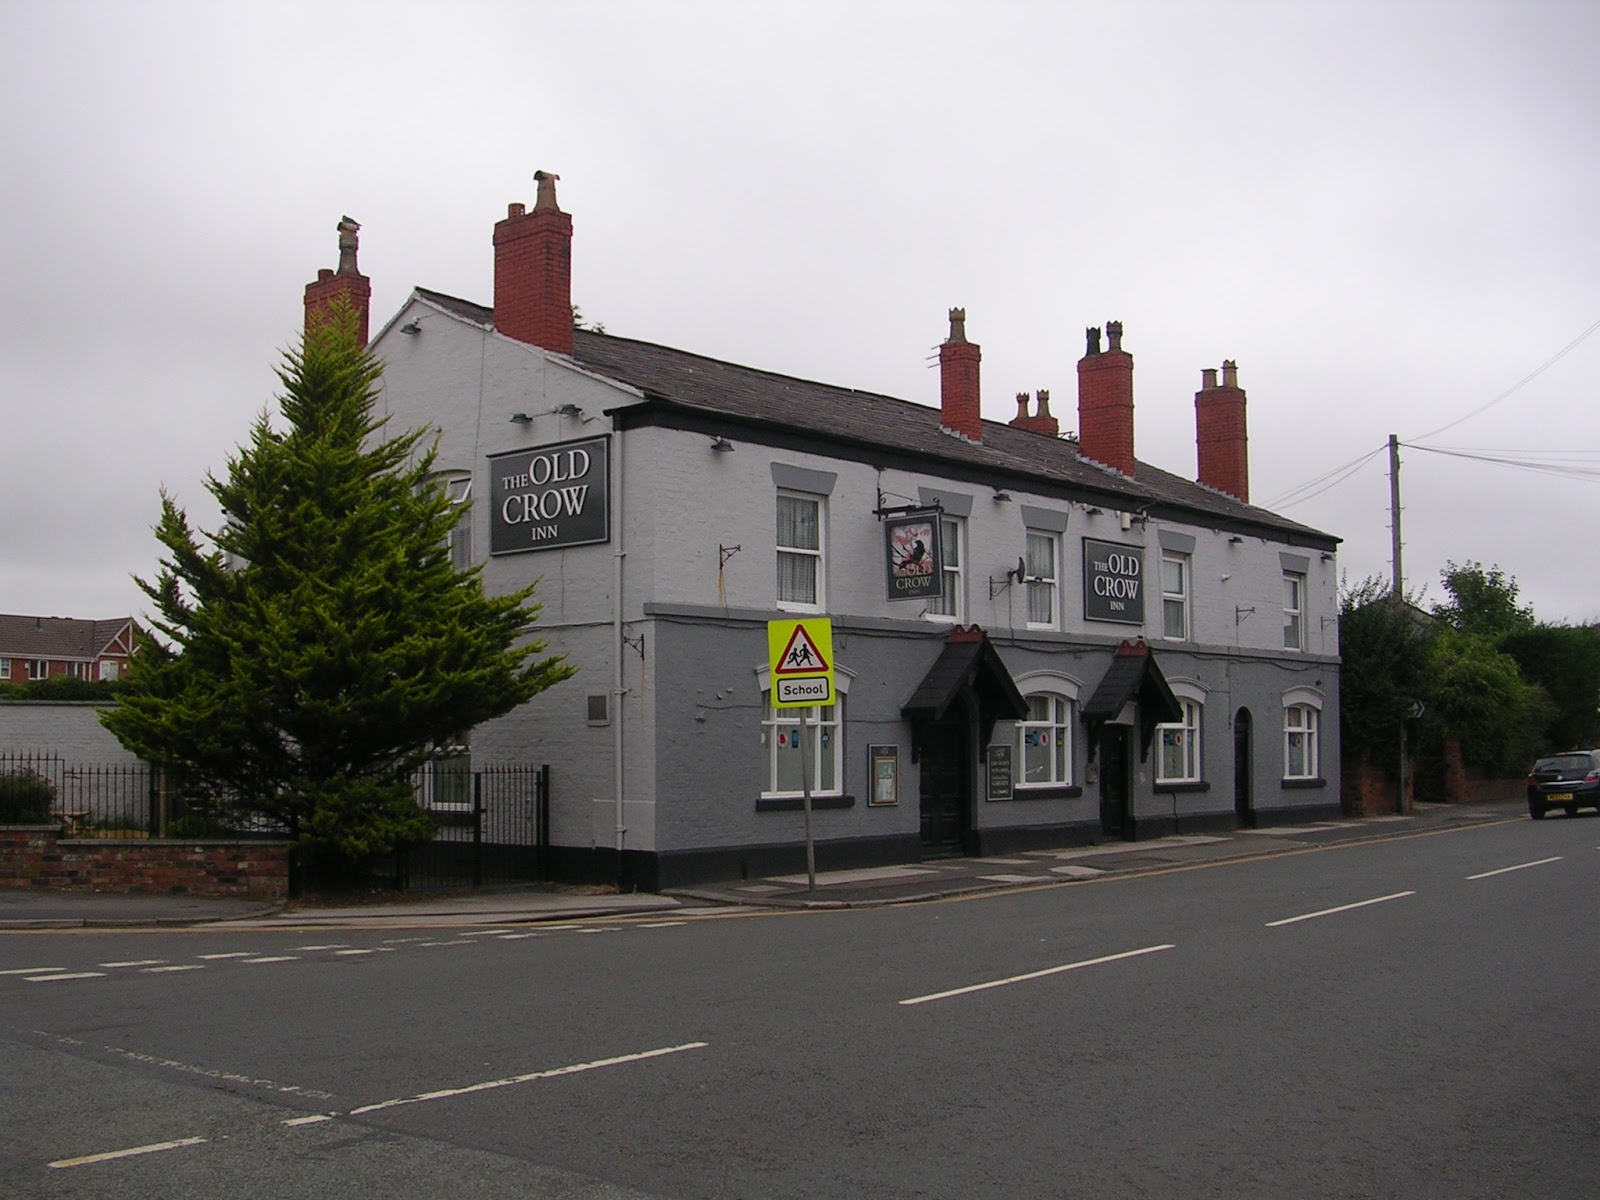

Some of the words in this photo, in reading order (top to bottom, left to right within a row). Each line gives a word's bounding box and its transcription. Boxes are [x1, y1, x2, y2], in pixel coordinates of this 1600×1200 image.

[502, 473, 529, 490] THE
[529, 449, 590, 486] OLD
[502, 484, 589, 524] CROW
[531, 524, 558, 541] INN
[906, 564, 932, 576] OLD
[1093, 561, 1109, 572] THE
[1108, 553, 1139, 576] OLD
[895, 576, 932, 590] CROW
[1094, 575, 1139, 600] CROW
[1110, 601, 1125, 611] INN
[784, 684, 823, 695] School
